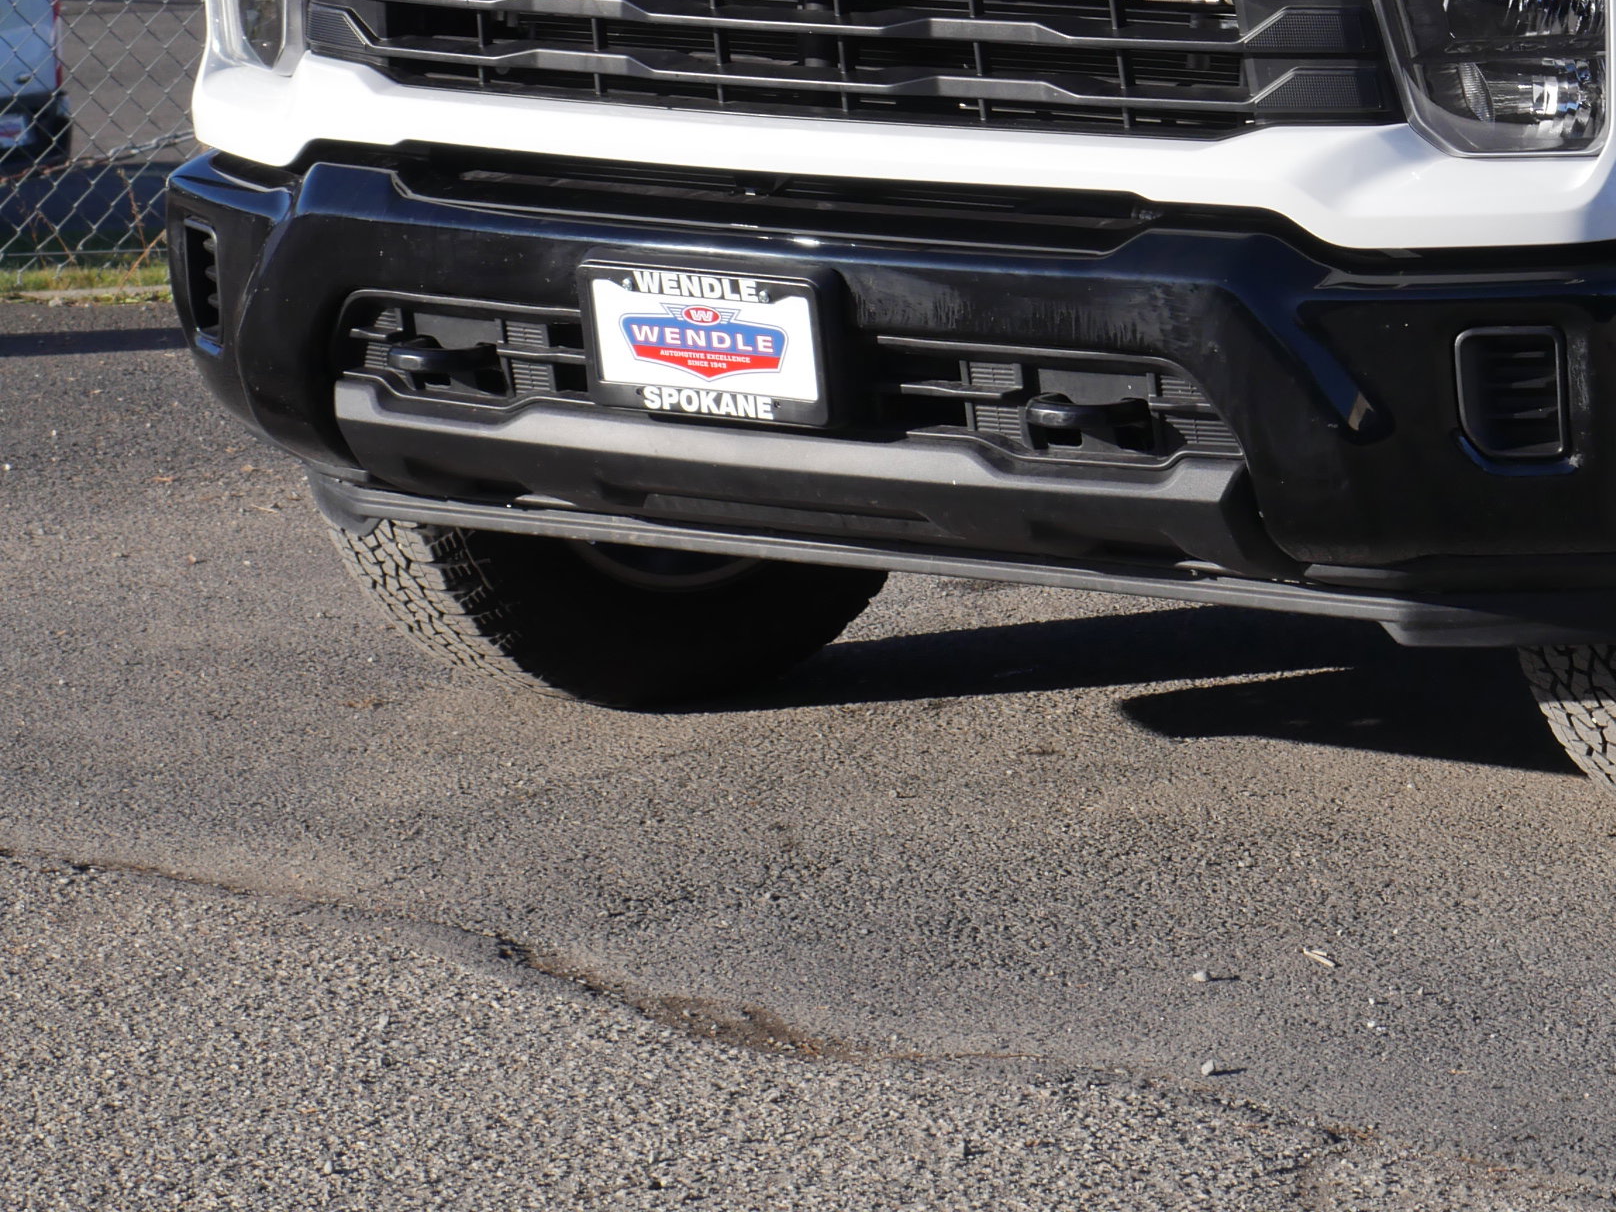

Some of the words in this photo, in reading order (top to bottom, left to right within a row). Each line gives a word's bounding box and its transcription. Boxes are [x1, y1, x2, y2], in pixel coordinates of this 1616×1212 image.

[633, 271, 759, 303] WENDLE
[631, 324, 774, 352] WENDLE
[660, 349, 705, 359] AUTOMOTIVE
[706, 353, 751, 363] EXCELLENCE
[687, 359, 709, 367] SINCE
[643, 386, 774, 420] SPOKANE
